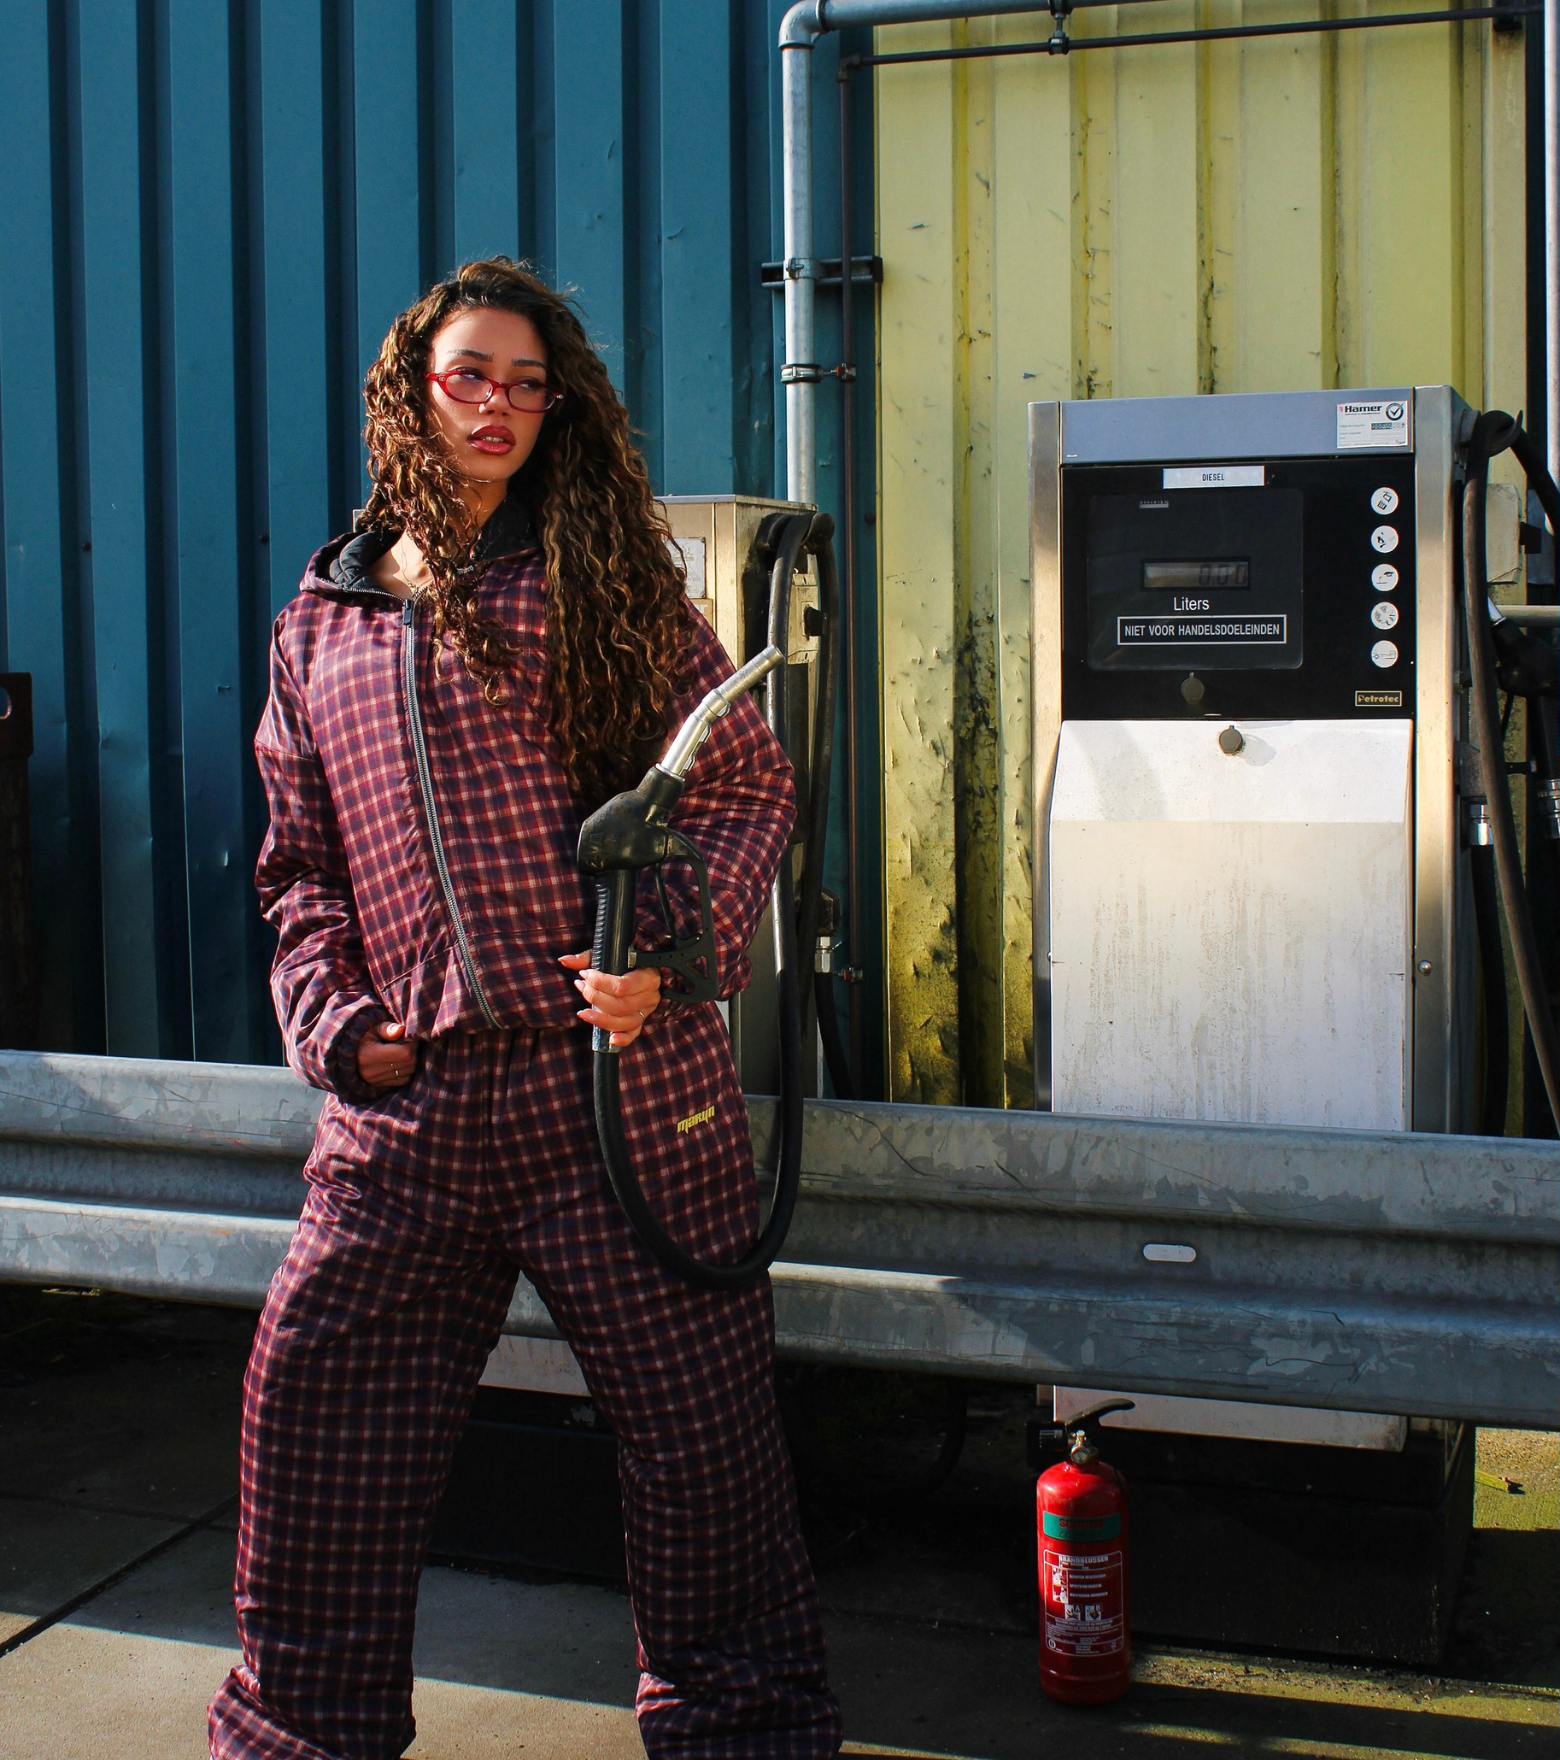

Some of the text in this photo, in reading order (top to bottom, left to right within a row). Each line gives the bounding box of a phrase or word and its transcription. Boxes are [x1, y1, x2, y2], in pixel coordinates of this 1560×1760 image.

[1202, 473, 1225, 482] DIESEL
[1173, 596, 1210, 611] Liters
[1124, 624, 1280, 637] NIET VOOR HANDELSDOELEINDEN
[1358, 694, 1399, 703] Petrotec
